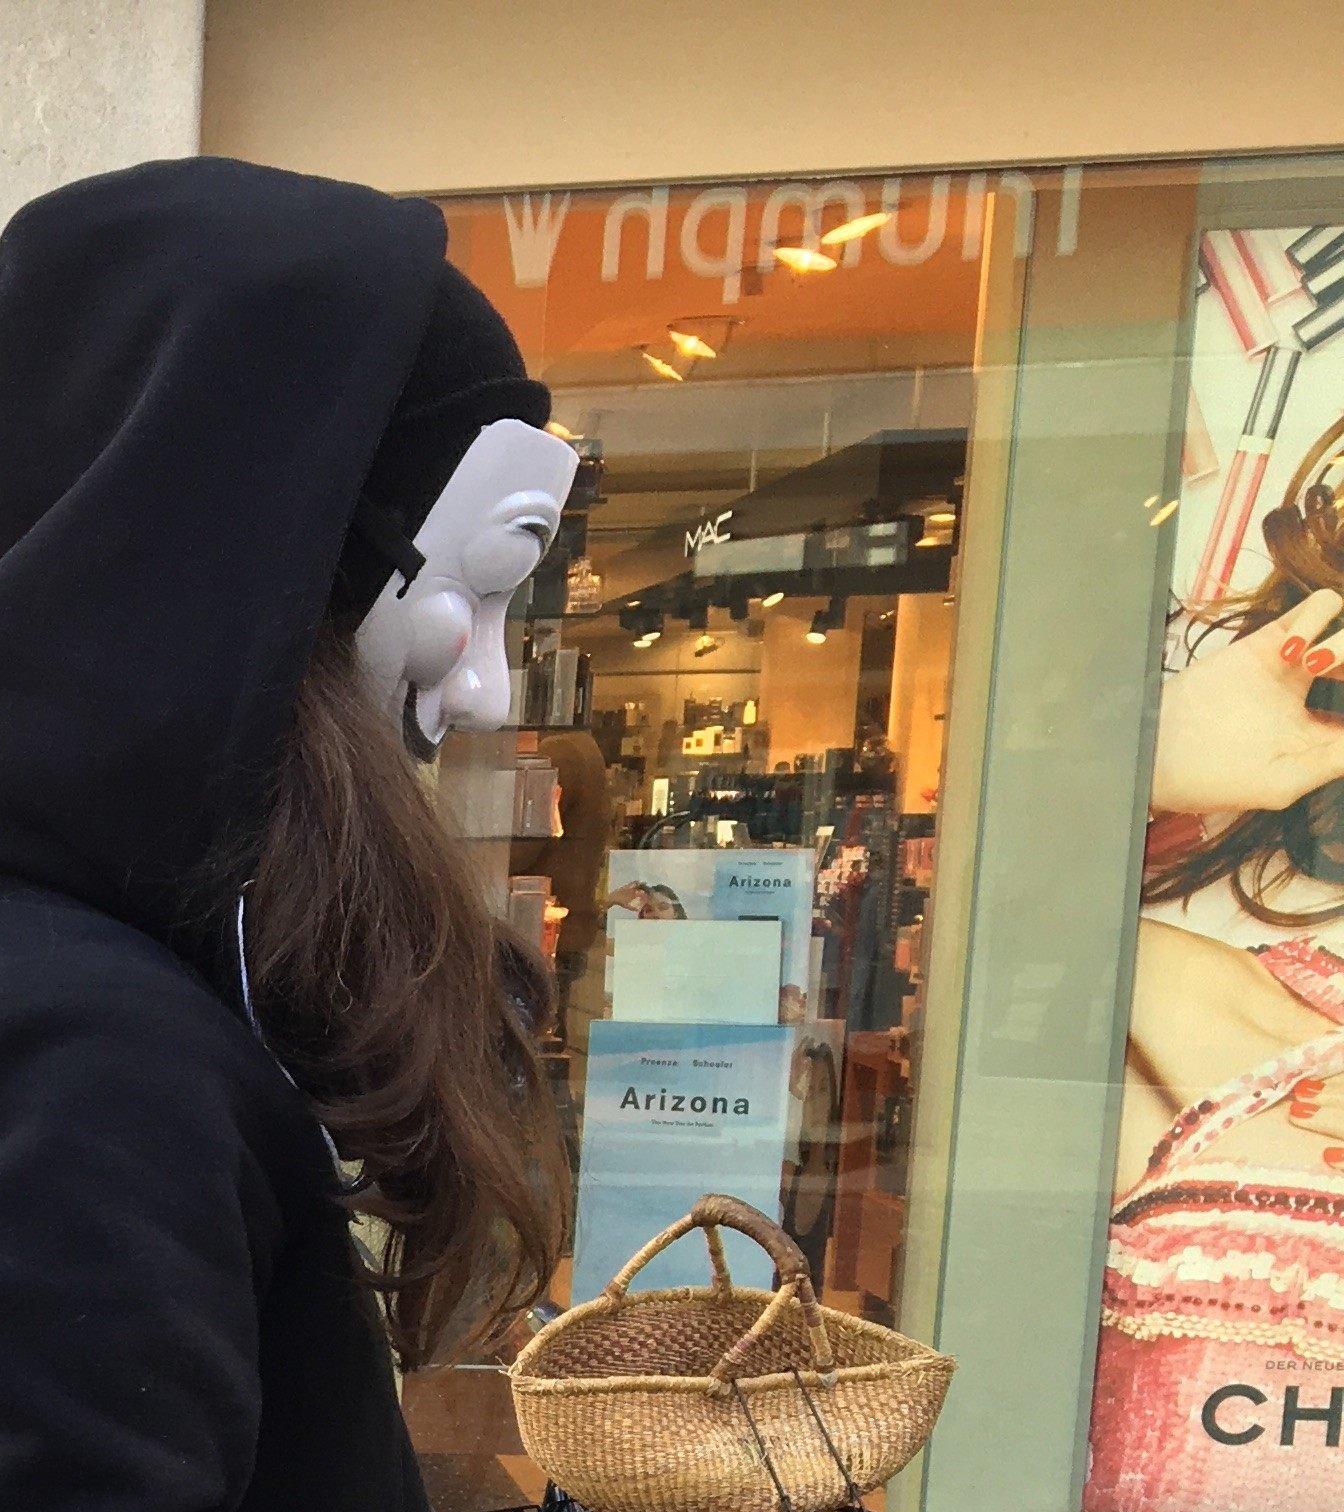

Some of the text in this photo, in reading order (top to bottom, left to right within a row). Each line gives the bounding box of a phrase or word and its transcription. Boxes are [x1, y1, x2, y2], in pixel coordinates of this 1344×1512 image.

[728, 875, 792, 889] Arizona
[620, 1086, 750, 1115] Arizona
[1265, 1360, 1344, 1371] DER NEUE
